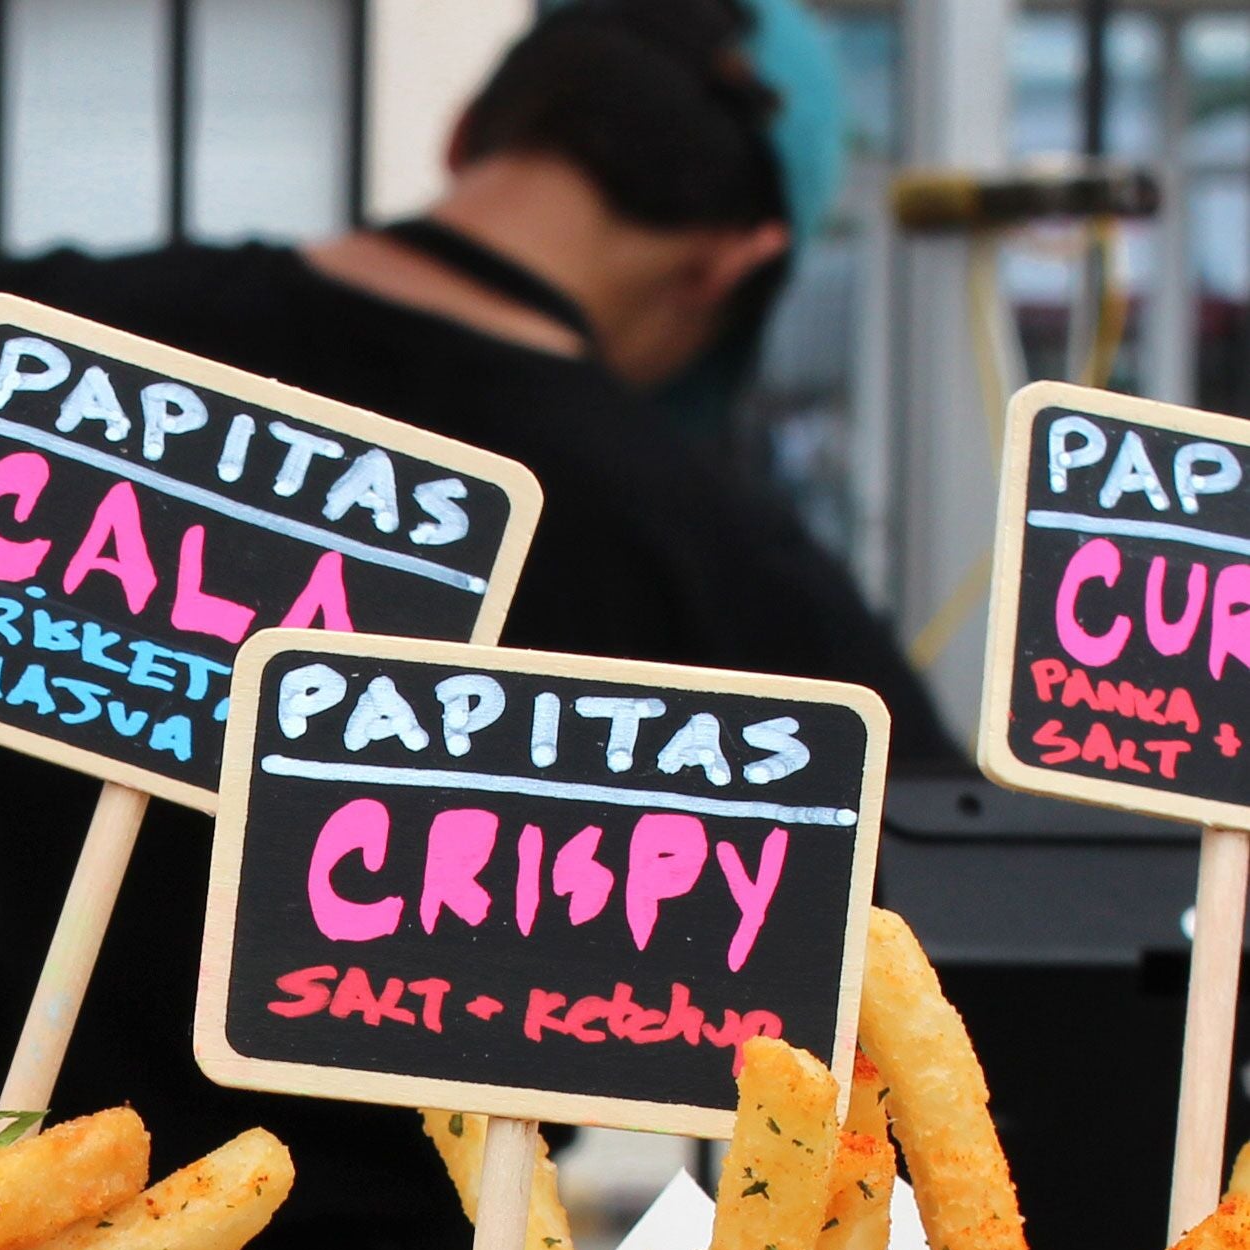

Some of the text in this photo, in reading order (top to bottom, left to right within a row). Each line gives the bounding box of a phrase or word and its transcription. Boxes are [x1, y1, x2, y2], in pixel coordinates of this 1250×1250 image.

[277, 662, 811, 787] PAPITAS
[1029, 657, 1201, 735] PANKA
[1031, 718, 1192, 780] SALT
[307, 798, 789, 973] CRISPY
[267, 964, 451, 1034] SALT
